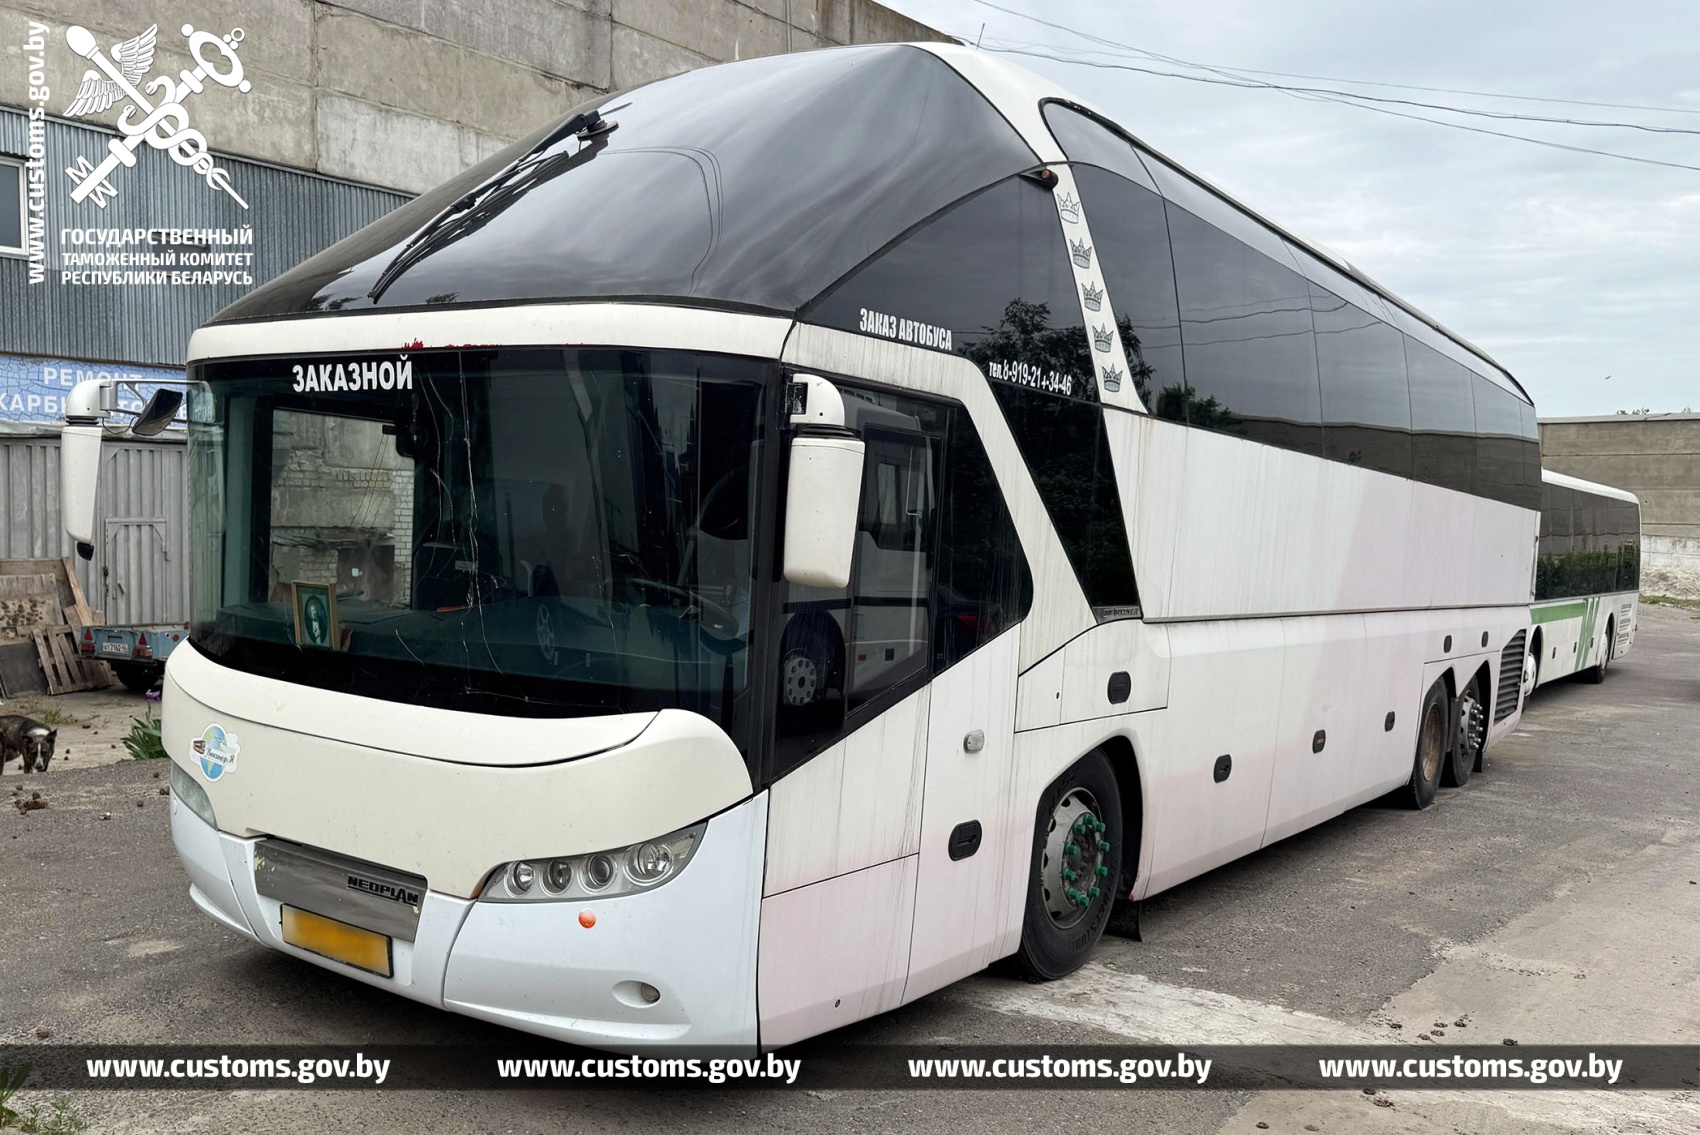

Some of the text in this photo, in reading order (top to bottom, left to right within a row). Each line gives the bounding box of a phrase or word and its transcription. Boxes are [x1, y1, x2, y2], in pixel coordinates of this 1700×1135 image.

[860, 307, 952, 350] ЗАКАЗ АВТОБУСА
[292, 354, 413, 392] ЗАКАЗНОЙ
[347, 876, 419, 905] NEOPLAN
